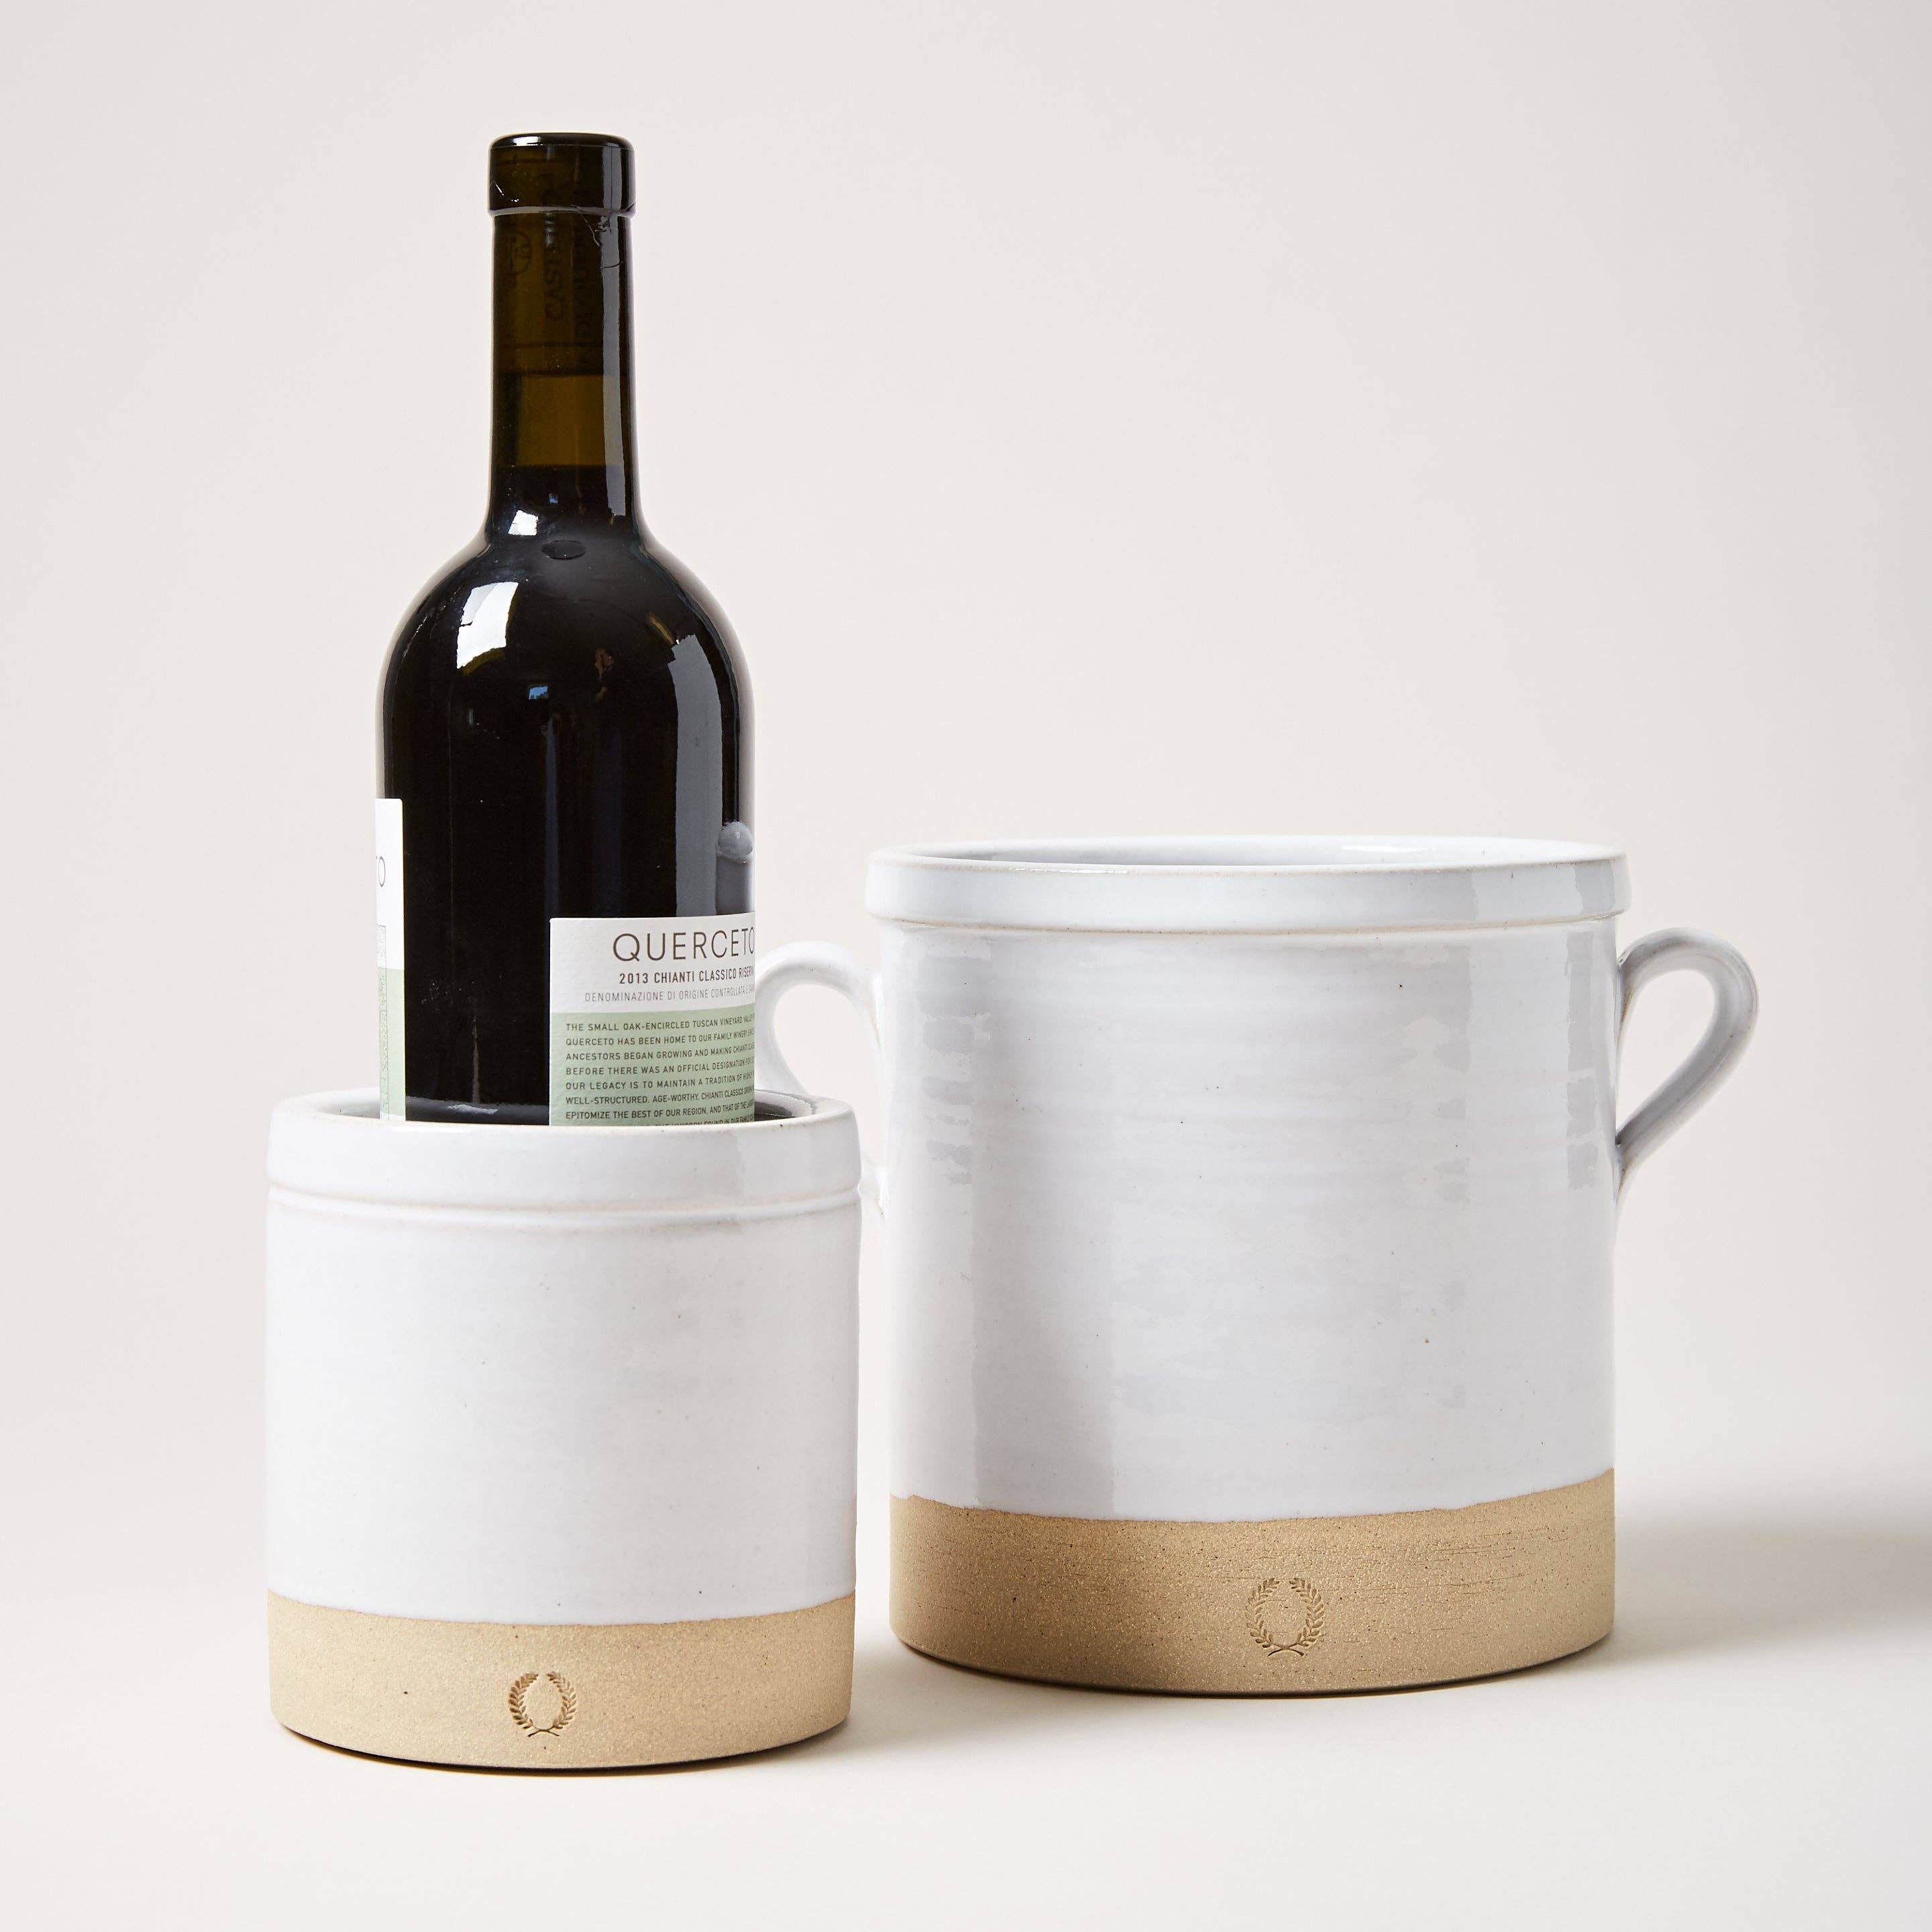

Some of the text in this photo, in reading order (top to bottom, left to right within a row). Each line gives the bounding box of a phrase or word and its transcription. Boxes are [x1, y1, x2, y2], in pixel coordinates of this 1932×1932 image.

[612, 926, 755, 961] QUERCETO
[620, 973, 648, 984] 2013
[654, 971, 694, 983] CHIANTI
[699, 969, 736, 981] CLASSICO
[585, 992, 663, 1002] DENOMINAZIONE
[668, 991, 675, 1000] DI
[680, 989, 708, 1000] ORIGINE
[623, 1022, 690, 1030] OAK-ENCIRCLED
[692, 1019, 718, 1028] TUSCAN
[720, 1016, 742, 1025] VINEYARD
[566, 1038, 614, 1046] QUERCETO
[664, 1036, 686, 1044] HOME
[699, 1034, 712, 1042] OUR
[714, 1032, 732, 1041] FAMILY
[624, 1052, 653, 1060] BEGAN
[657, 1050, 692, 1059] GROWING
[694, 1049, 708, 1057] AND
[710, 1046, 731, 1057] MAKING
[566, 1067, 604, 1075] BEFORE
[608, 1067, 637, 1075] THERE
[641, 1066, 659, 1074] WAS
[677, 1063, 710, 1072] OFFICIAL
[712, 1060, 745, 1071] DESIGNATION
[566, 1082, 585, 1090] OUR
[643, 1081, 653, 1089] TO
[657, 1079, 696, 1088] MAINTAIN
[706, 1075, 735, 1085] TRADITION
[702, 1091, 723, 1100] CHIANTI
[725, 1088, 743, 1098] CLASSICO
[566, 1111, 610, 1119] EPITOMIZE
[631, 1110, 651, 1118] BEST
[654, 1110, 663, 1118] OF
[710, 1106, 721, 1114] AND
[722, 1104, 734, 1112] THAT
